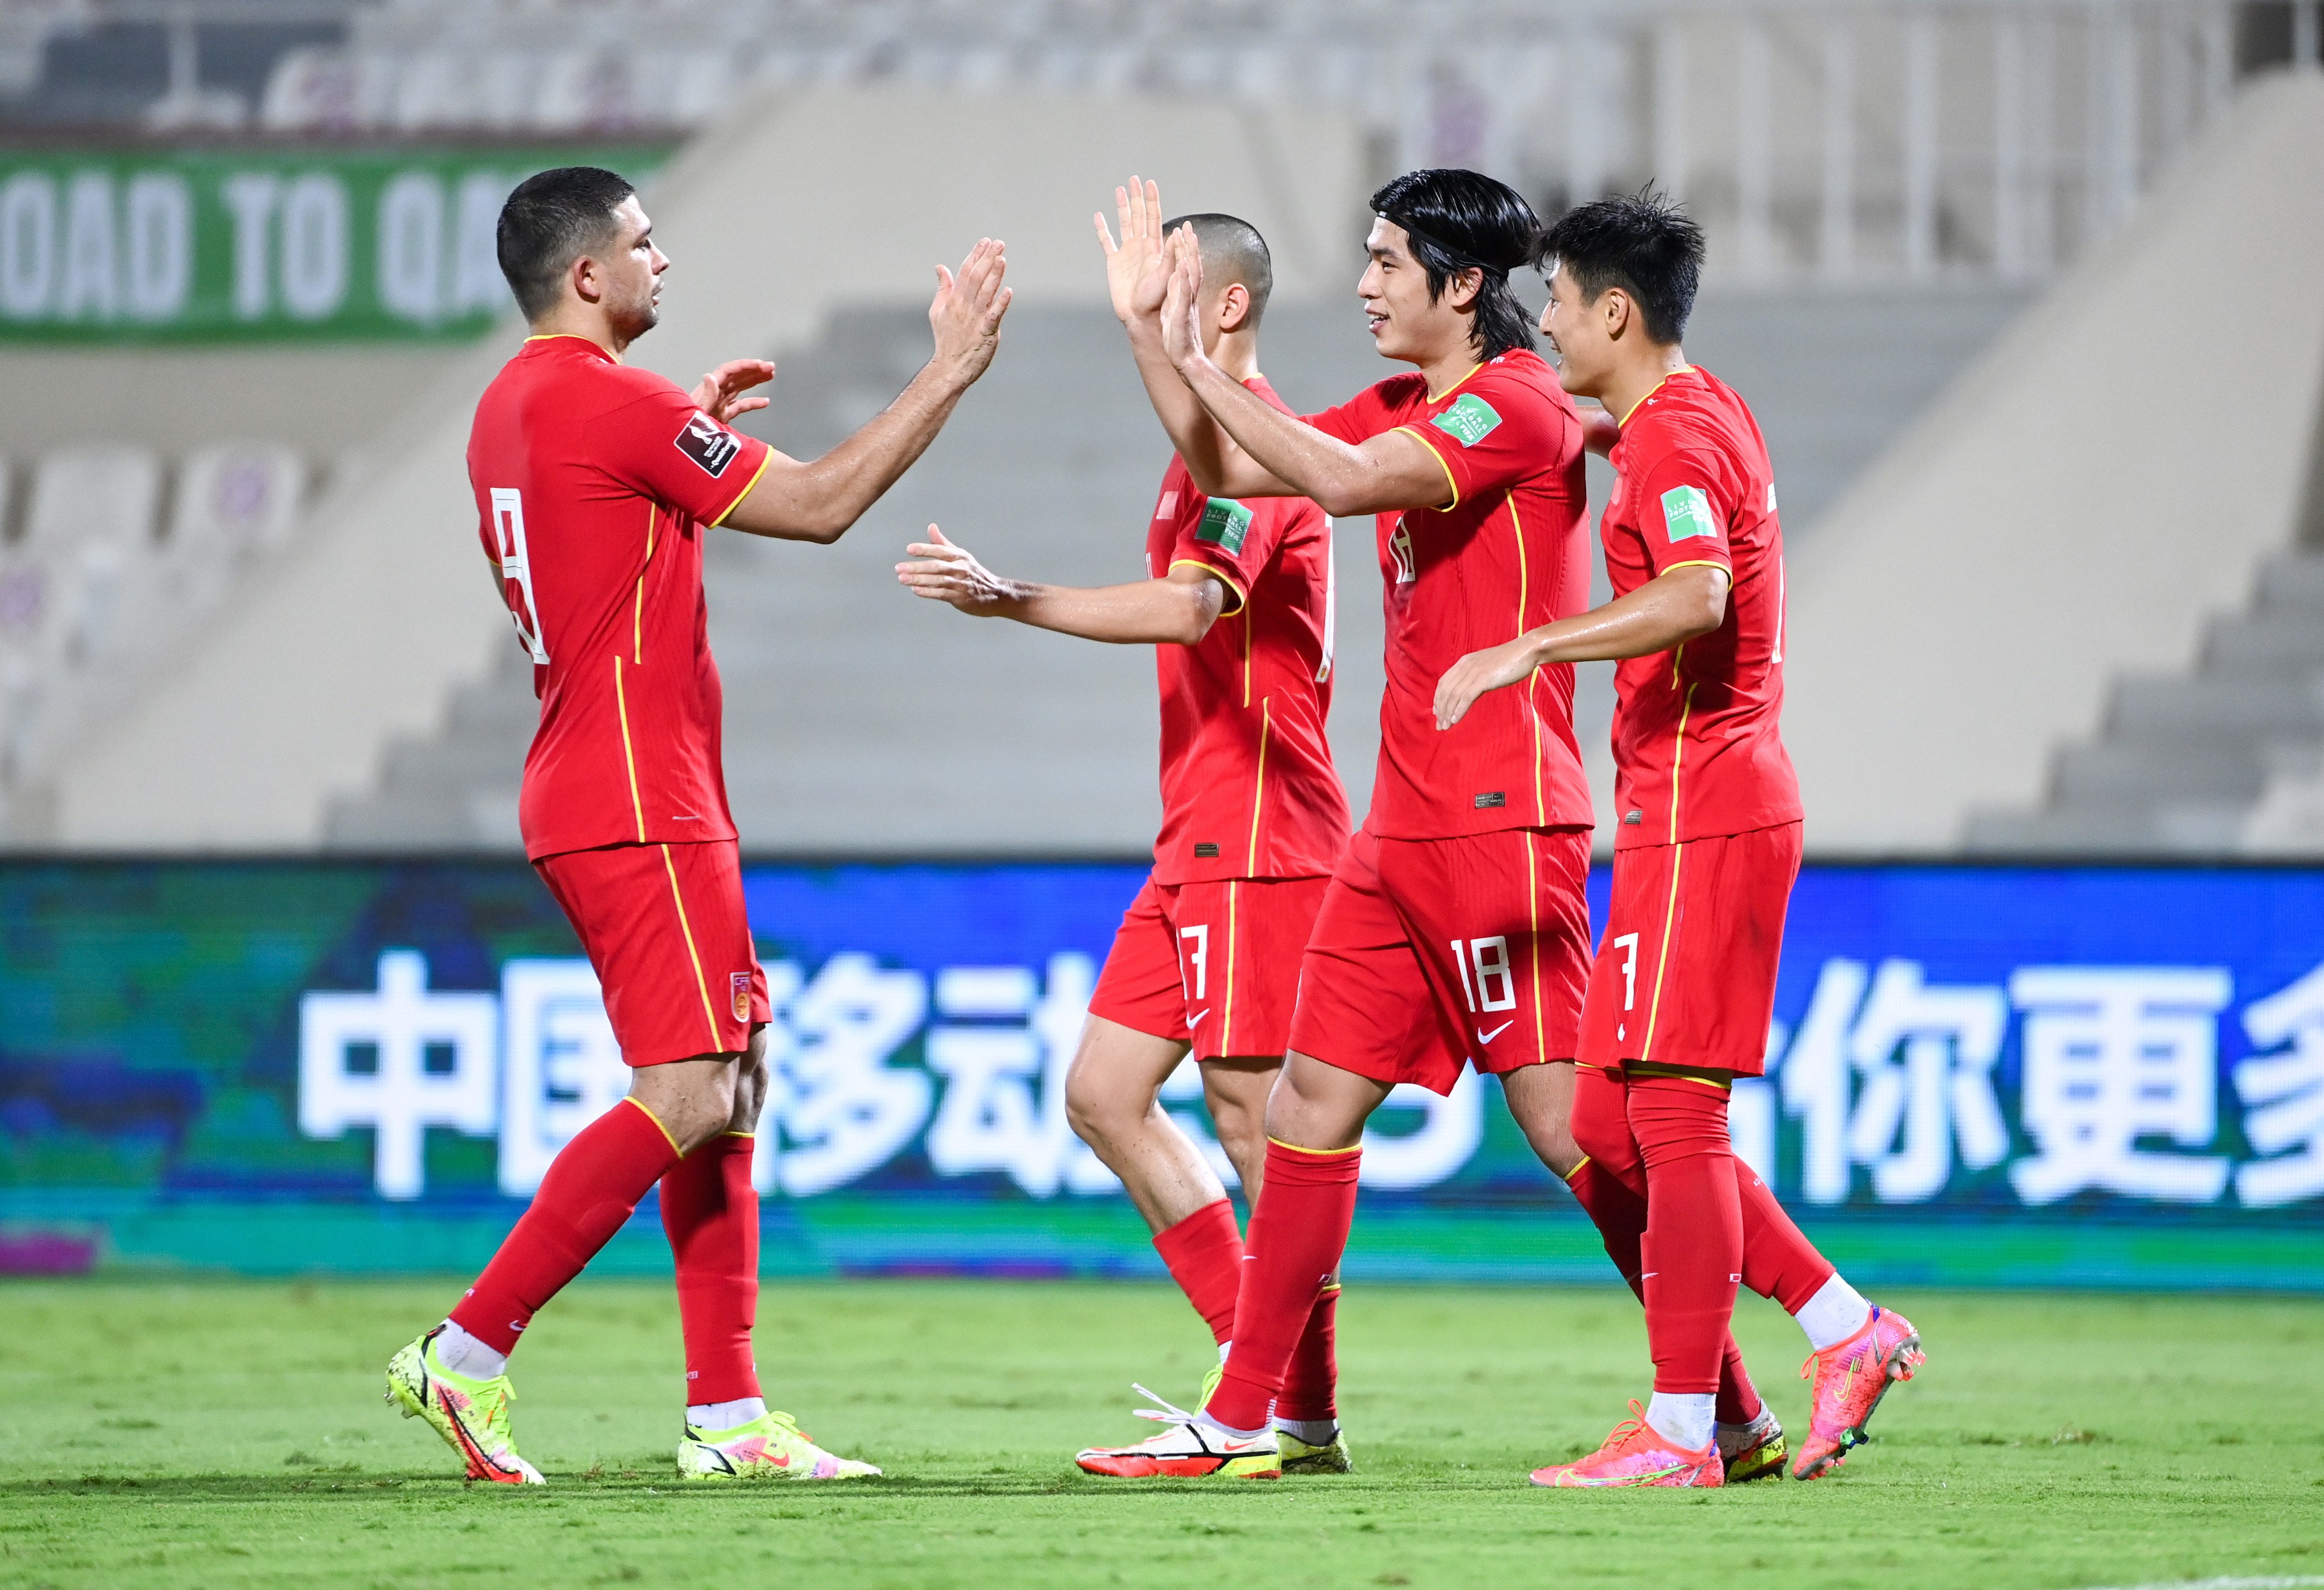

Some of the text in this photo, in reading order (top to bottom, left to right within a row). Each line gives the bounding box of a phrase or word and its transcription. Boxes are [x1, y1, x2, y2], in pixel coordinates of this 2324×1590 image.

[221, 173, 349, 317] TO
[377, 171, 528, 323] QA
[1452, 407, 1482, 434] FOOBALL
[1455, 403, 1487, 430] LIVING
[1460, 424, 1475, 441] FIFA
[490, 487, 551, 665] 9
[1450, 935, 1516, 1013] 18
[1614, 931, 1639, 1011] 7
